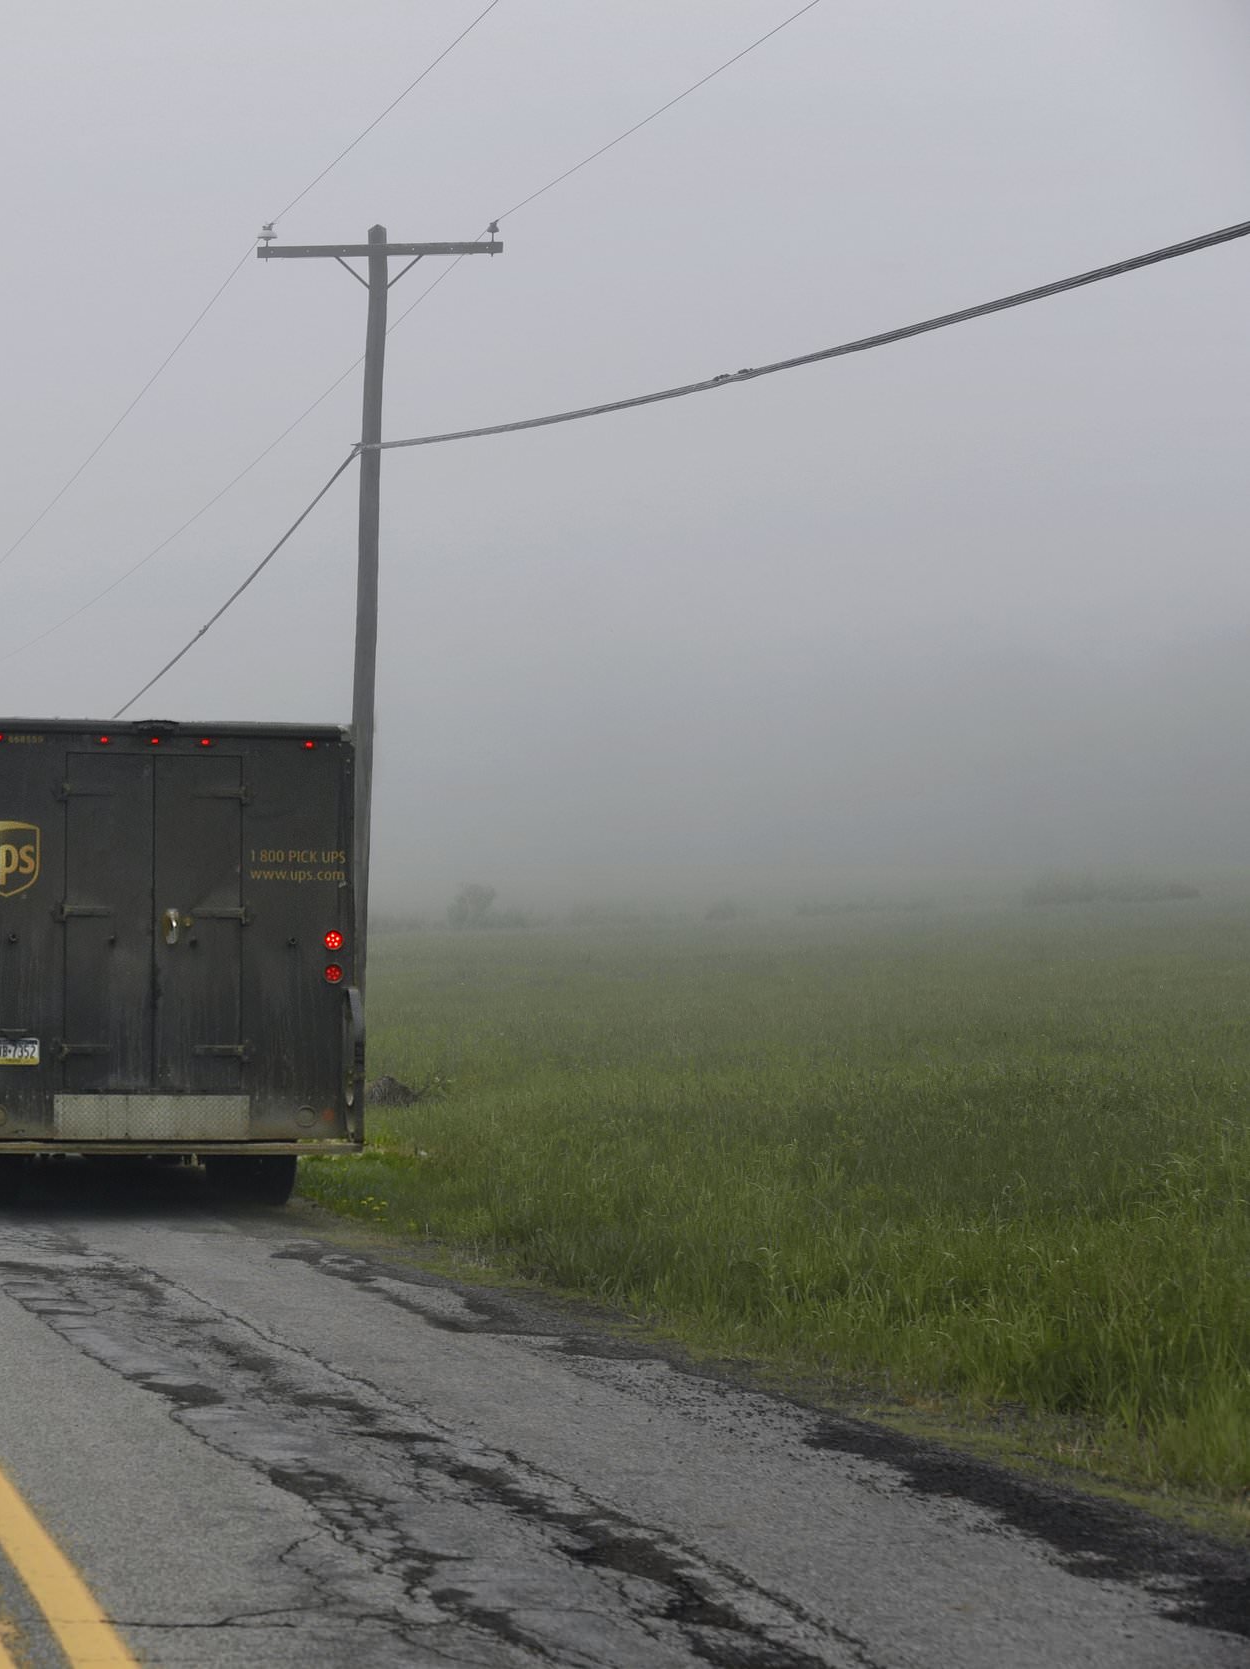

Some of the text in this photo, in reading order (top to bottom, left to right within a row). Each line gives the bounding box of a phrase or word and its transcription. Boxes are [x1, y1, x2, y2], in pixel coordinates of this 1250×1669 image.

[250, 849, 346, 864] 1 800 PICK UPS
[250, 870, 346, 884] www.ups.com
